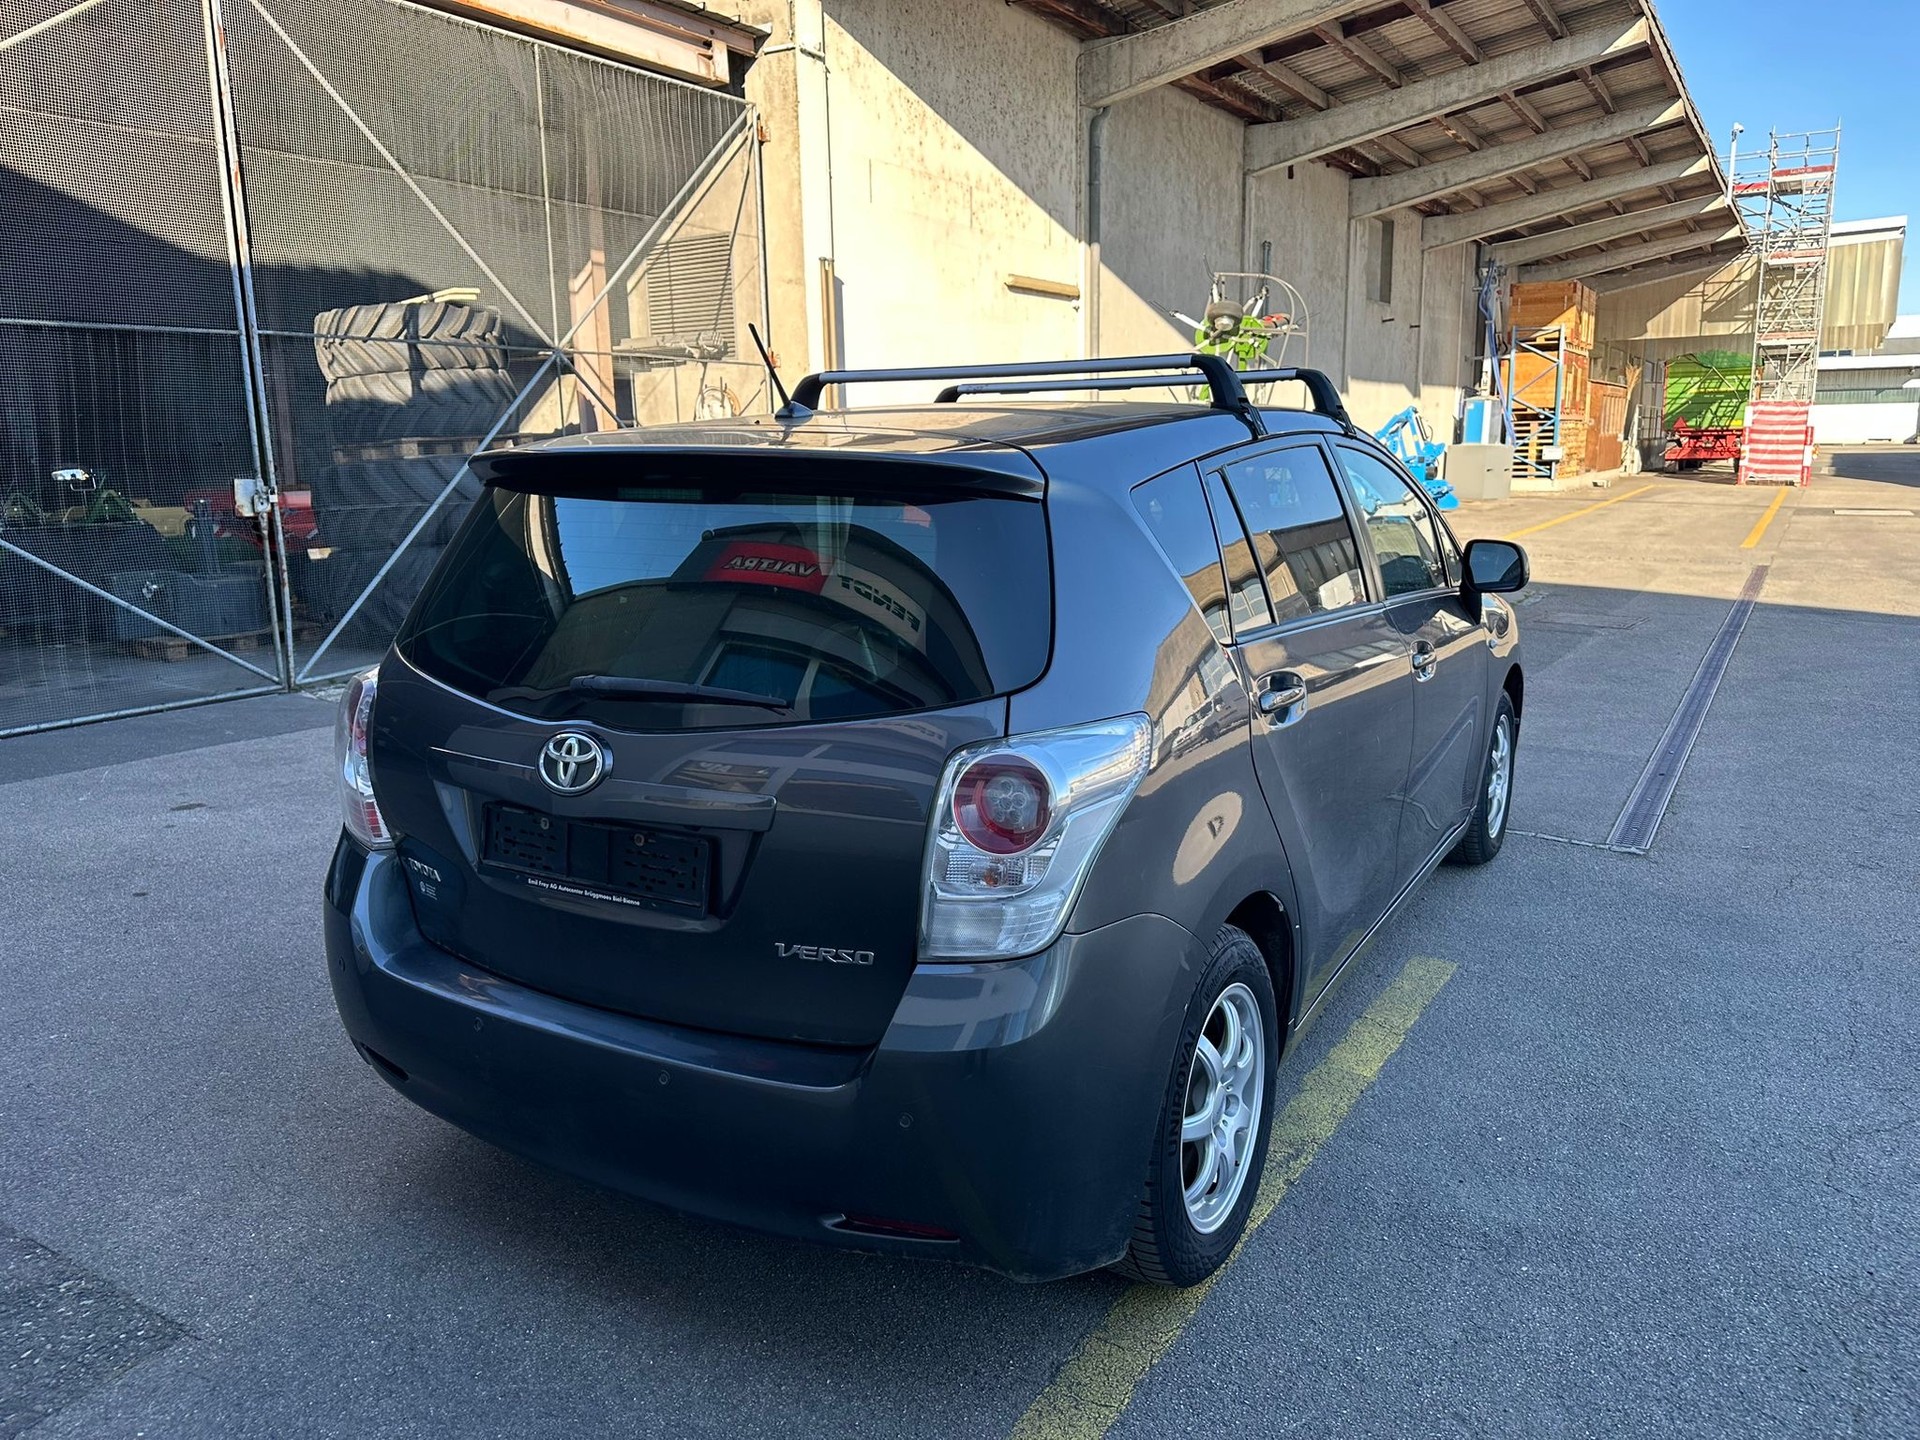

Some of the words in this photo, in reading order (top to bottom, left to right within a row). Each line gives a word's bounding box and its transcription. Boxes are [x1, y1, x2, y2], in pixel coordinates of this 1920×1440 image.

[538, 880, 549, 889] Frey
[558, 885, 583, 895] Autocenter
[774, 942, 875, 966] VERSO
[1167, 1026, 1199, 1157] UNIROYAL
